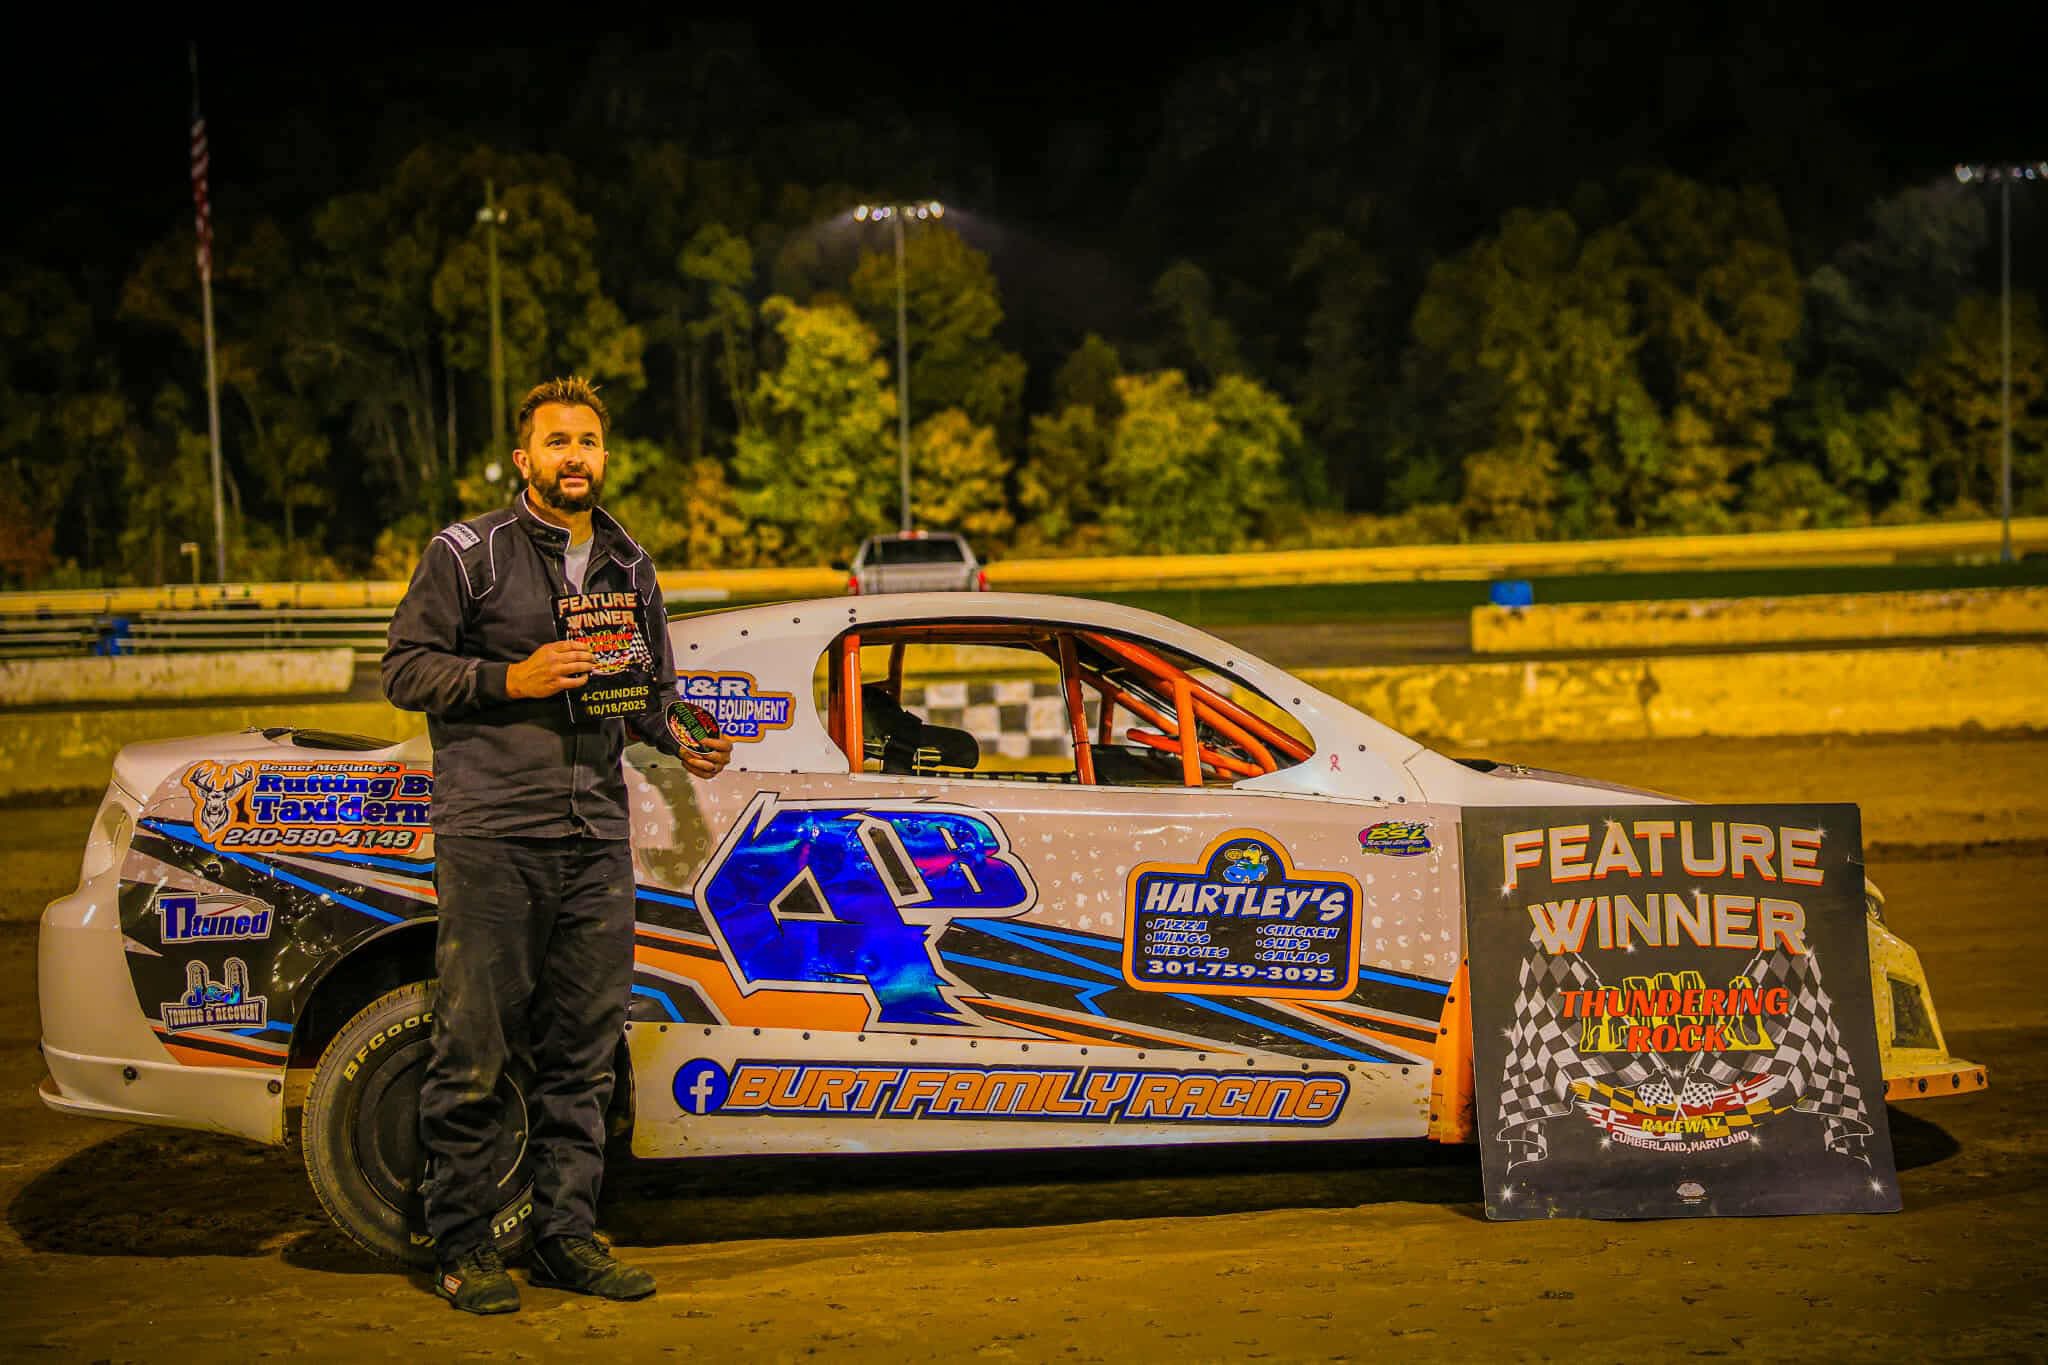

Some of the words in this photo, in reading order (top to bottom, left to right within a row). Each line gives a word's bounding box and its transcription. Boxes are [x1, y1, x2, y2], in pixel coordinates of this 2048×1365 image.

[558, 593, 638, 617] FEATURE
[567, 610, 635, 628] WINNER
[581, 685, 649, 702] 4-CYLINDERS
[587, 699, 647, 716] 10/18/2025
[719, 700, 787, 723] EQUIPMENT
[316, 763, 399, 774] McKinley's
[255, 774, 396, 799] Rutting
[252, 795, 431, 825] Taxiderm
[223, 827, 416, 849] 240-580-4148
[1502, 820, 1826, 889] FEATURE
[1143, 881, 1346, 921] HARTLEY'S
[1153, 919, 1208, 932] PIZZA
[1264, 925, 1341, 939] CHICKEN
[1527, 893, 1811, 956] WINNER
[1152, 933, 1211, 945] WINGS
[1263, 938, 1311, 950] SUBS
[1151, 944, 1230, 958] WEDGIES
[1262, 951, 1331, 964] SALADS
[1147, 959, 1336, 982] 301-759-3095
[1559, 986, 1791, 1018] THUNDERING
[167, 1007, 204, 1026] TOWING
[215, 1002, 260, 1021] RECOVERY
[1627, 1024, 1729, 1053] ROCK
[725, 1066, 897, 1111] BURT
[893, 1068, 1132, 1115] FAMILY
[1129, 1074, 1343, 1119] RACING
[1641, 1117, 1722, 1133] RACEWAY
